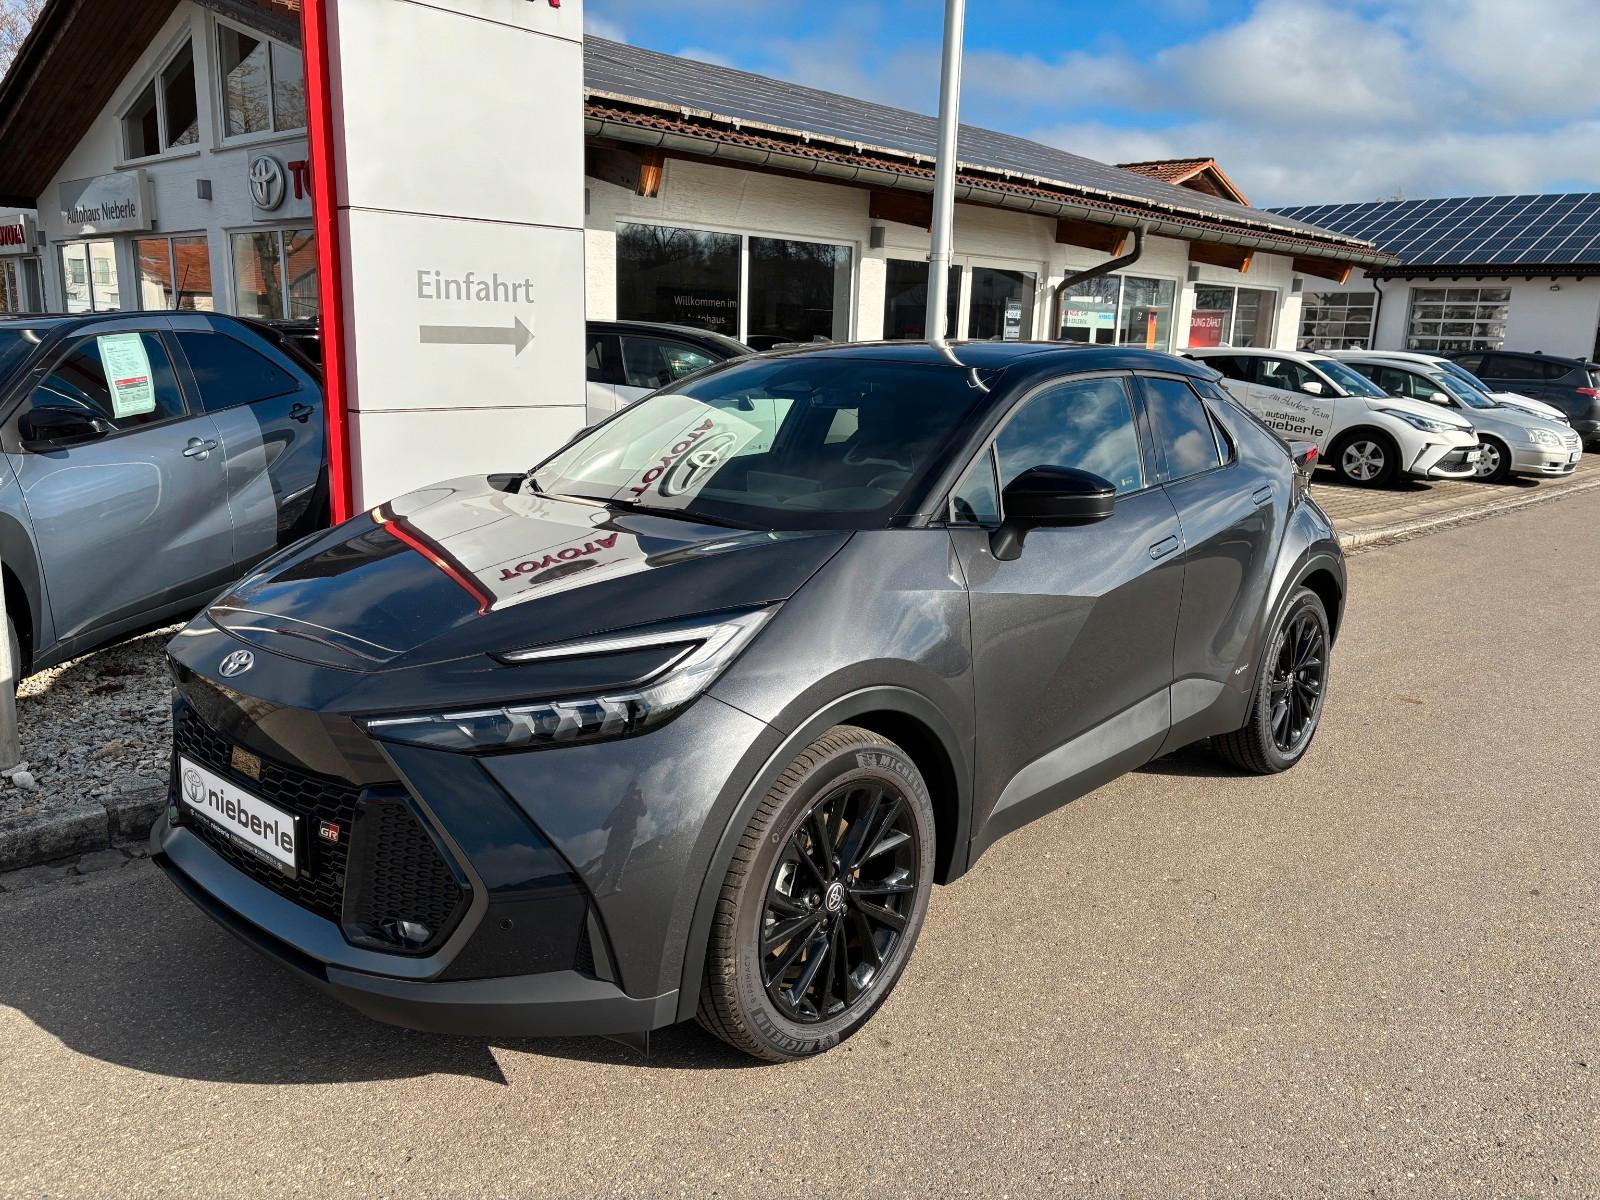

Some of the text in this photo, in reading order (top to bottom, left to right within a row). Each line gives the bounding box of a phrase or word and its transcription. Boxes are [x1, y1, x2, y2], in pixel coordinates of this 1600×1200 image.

[67, 199, 136, 224] Autohaus Nieberle
[417, 269, 535, 304] Einfahrt
[673, 295, 737, 308] Willkommen im
[1264, 419, 1324, 437] nieberle
[1265, 410, 1306, 424] autohaus
[880, 755, 930, 811] MICHELIN
[208, 789, 294, 853] nieberle
[320, 827, 339, 841] GR
[752, 1012, 817, 1053] MICHELIN
